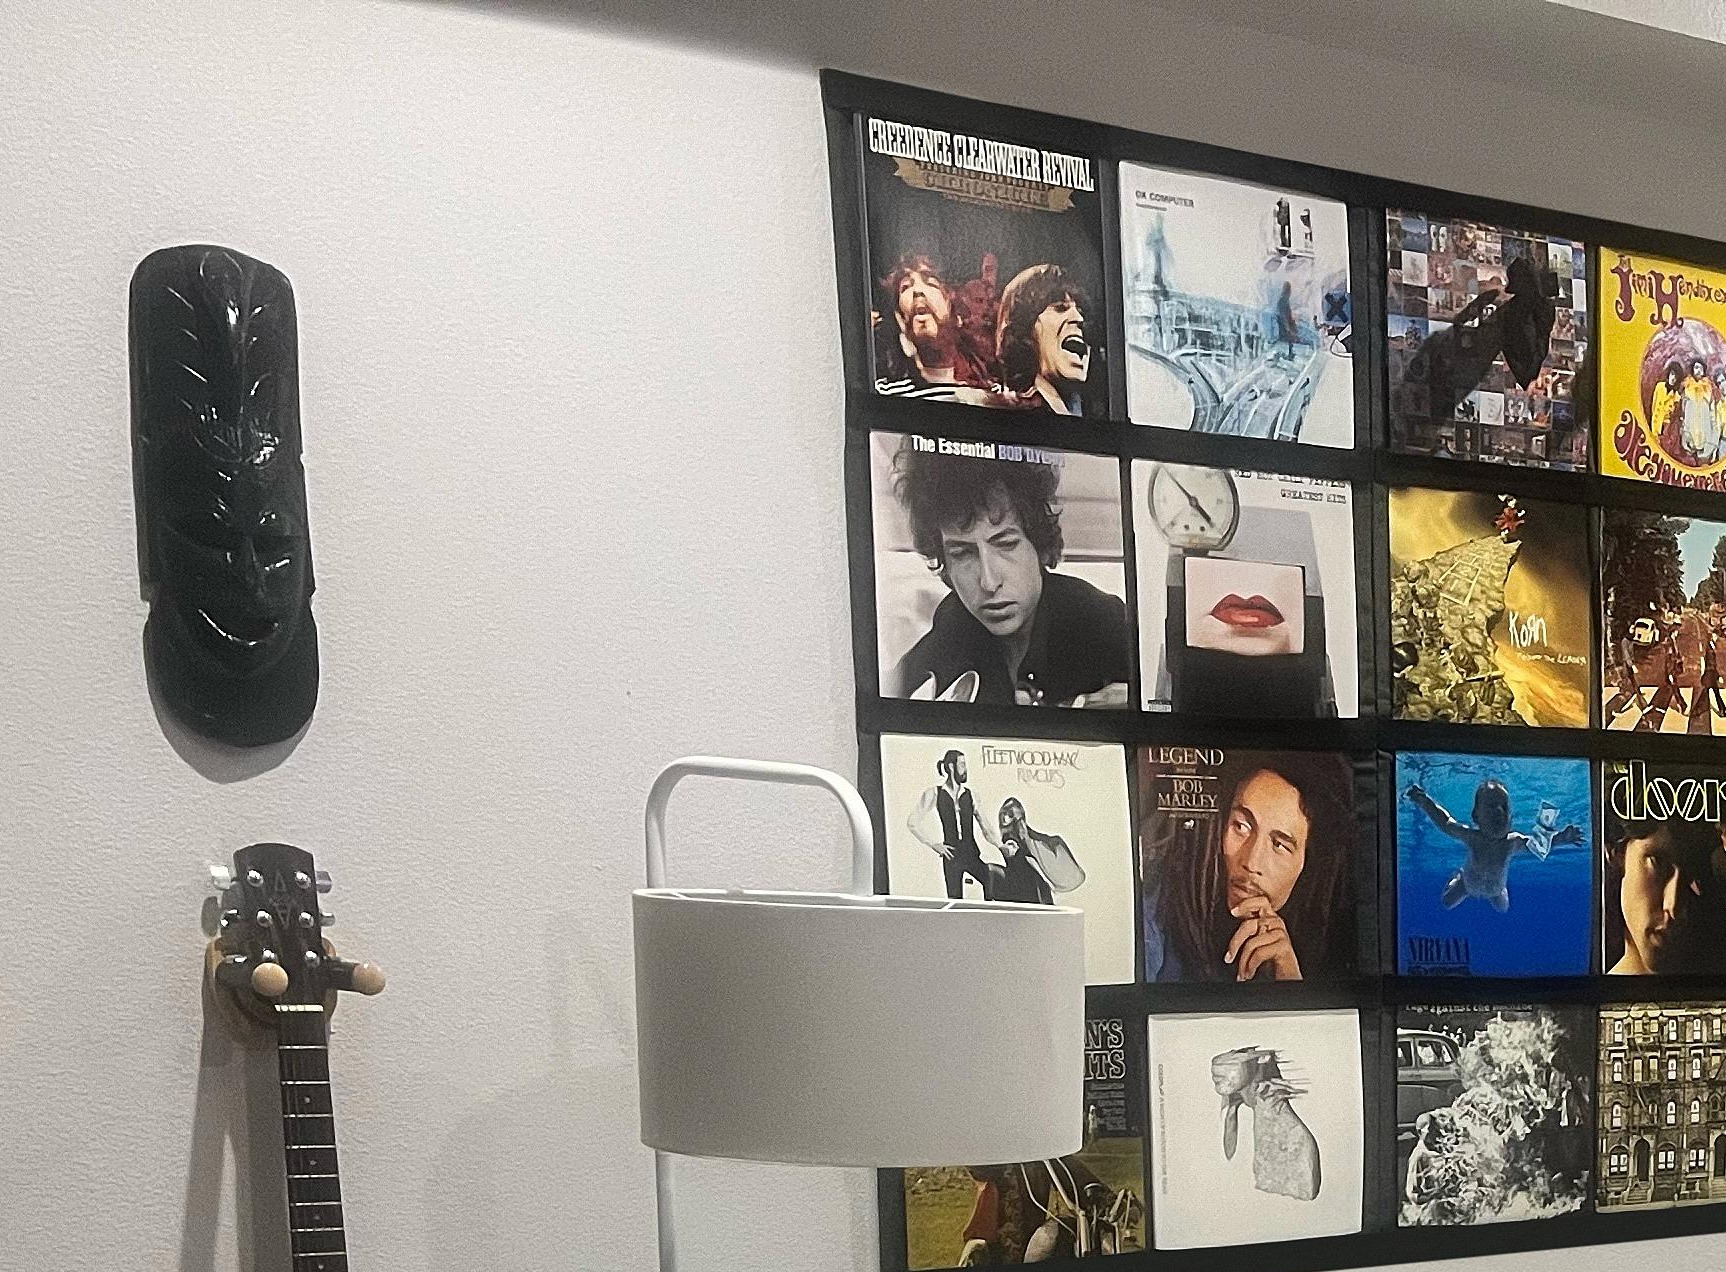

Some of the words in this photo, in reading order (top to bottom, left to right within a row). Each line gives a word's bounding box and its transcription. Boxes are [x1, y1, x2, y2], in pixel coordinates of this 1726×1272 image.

[869, 117, 951, 167] CREEDENCE
[952, 134, 1042, 183] CLEARWATER
[1041, 150, 1095, 192] REVIVAL
[912, 435, 935, 452] The
[938, 438, 996, 459] Essential
[998, 444, 1022, 462] BOB
[982, 745, 1051, 768] FLEETWOOD
[1148, 747, 1224, 766] LEGEND
[1173, 779, 1203, 793] BOB
[1158, 793, 1218, 808] MARLEY
[1408, 937, 1469, 961] NIRVANA
